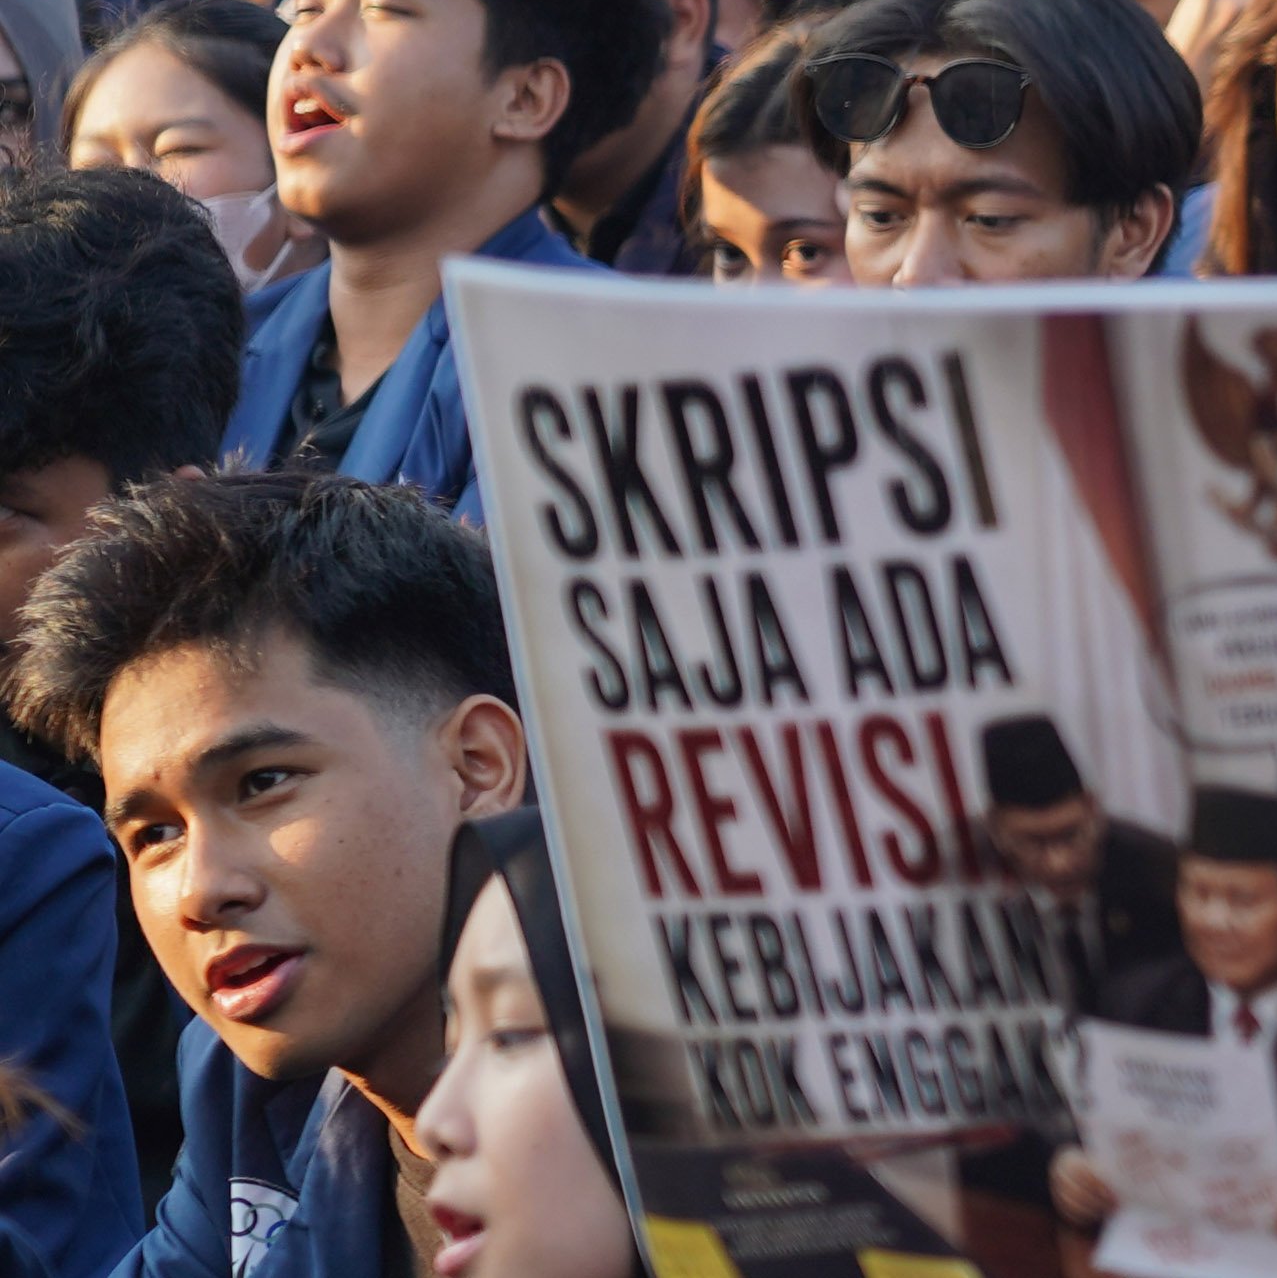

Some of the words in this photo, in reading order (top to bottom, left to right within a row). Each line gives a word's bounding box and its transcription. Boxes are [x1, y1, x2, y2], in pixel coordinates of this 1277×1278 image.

[517, 348, 1000, 563] SKRIPSI
[564, 570, 808, 713] SAJA
[831, 552, 1014, 698] ADA
[657, 897, 1054, 1026] KEBIJAKAN
[692, 1032, 818, 1128] KOK
